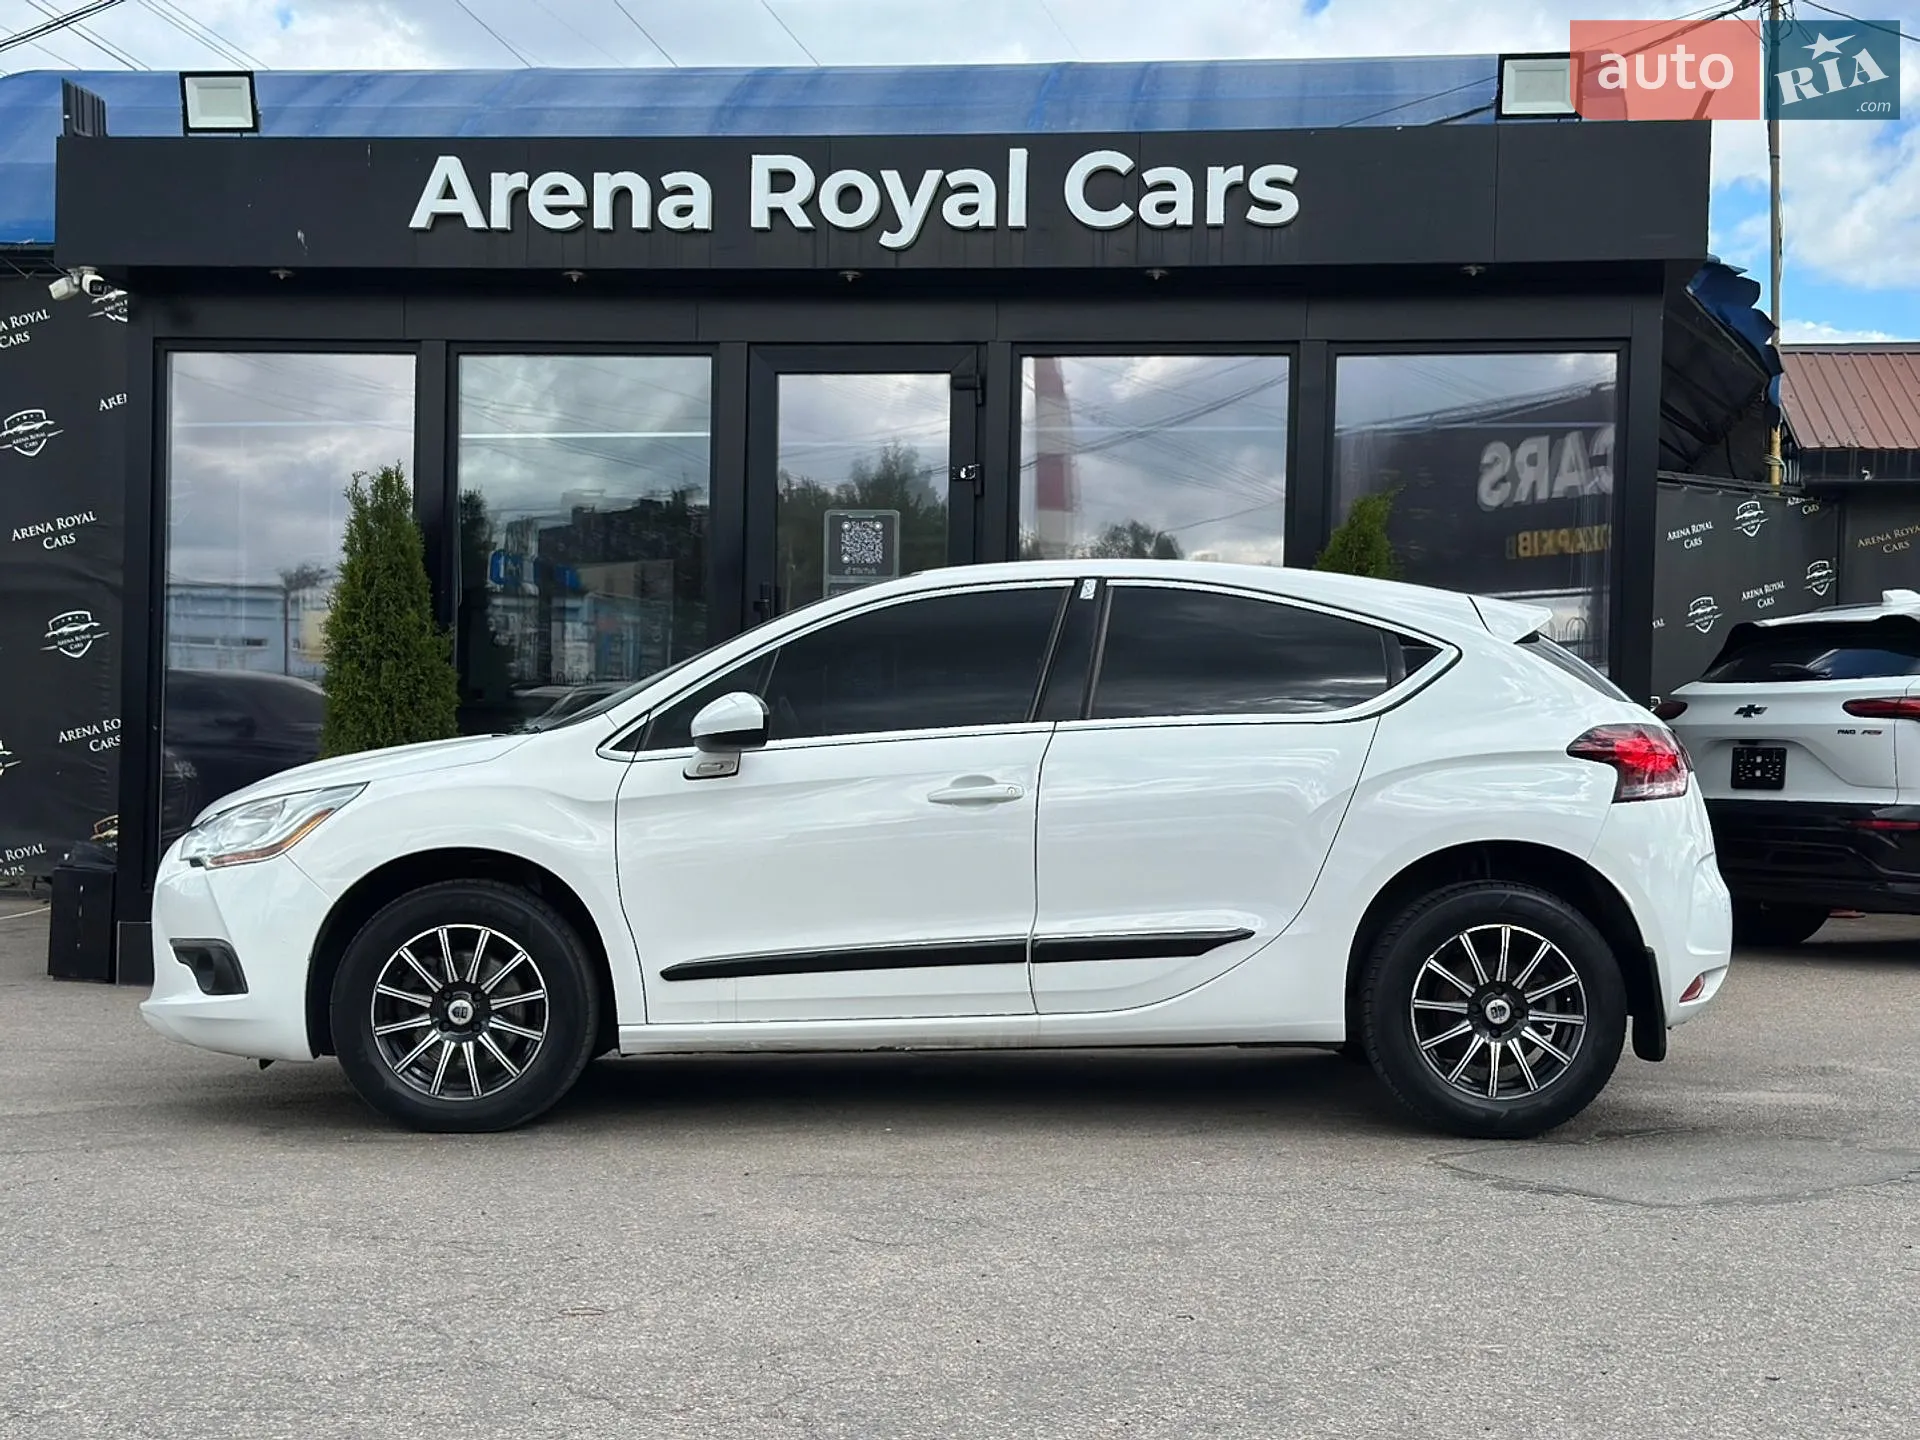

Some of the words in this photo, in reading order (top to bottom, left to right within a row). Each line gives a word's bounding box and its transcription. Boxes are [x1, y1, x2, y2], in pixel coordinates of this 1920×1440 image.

[408, 154, 713, 232] Arena
[750, 147, 1028, 251] Royal
[1065, 150, 1300, 229] Cars
[12, 522, 54, 541] ARENA
[56, 511, 96, 529] ROYAL
[43, 533, 76, 549] CARS
[59, 725, 100, 743] ARENA
